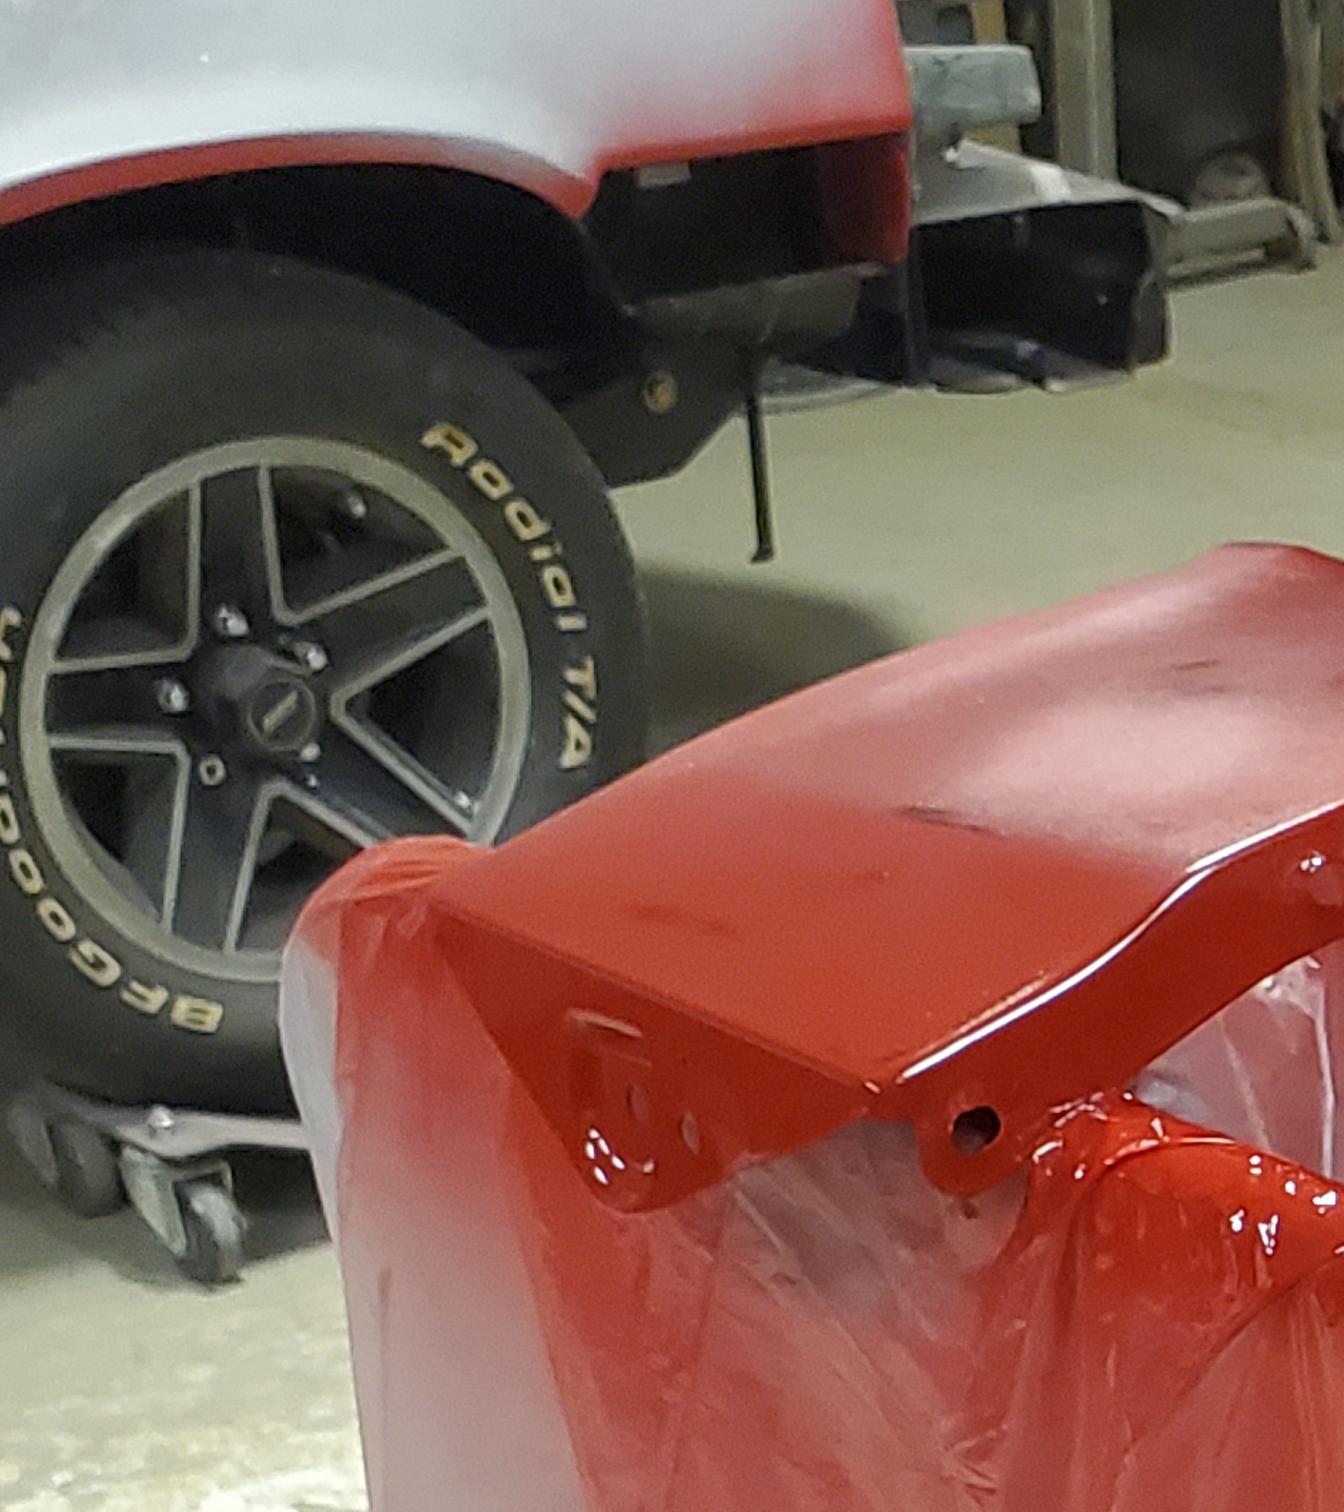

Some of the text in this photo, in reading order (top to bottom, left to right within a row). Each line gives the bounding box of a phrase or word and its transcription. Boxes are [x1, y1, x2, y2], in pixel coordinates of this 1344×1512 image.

[420, 422, 597, 770] Radial T/A
[0, 605, 224, 1035] BFGood
